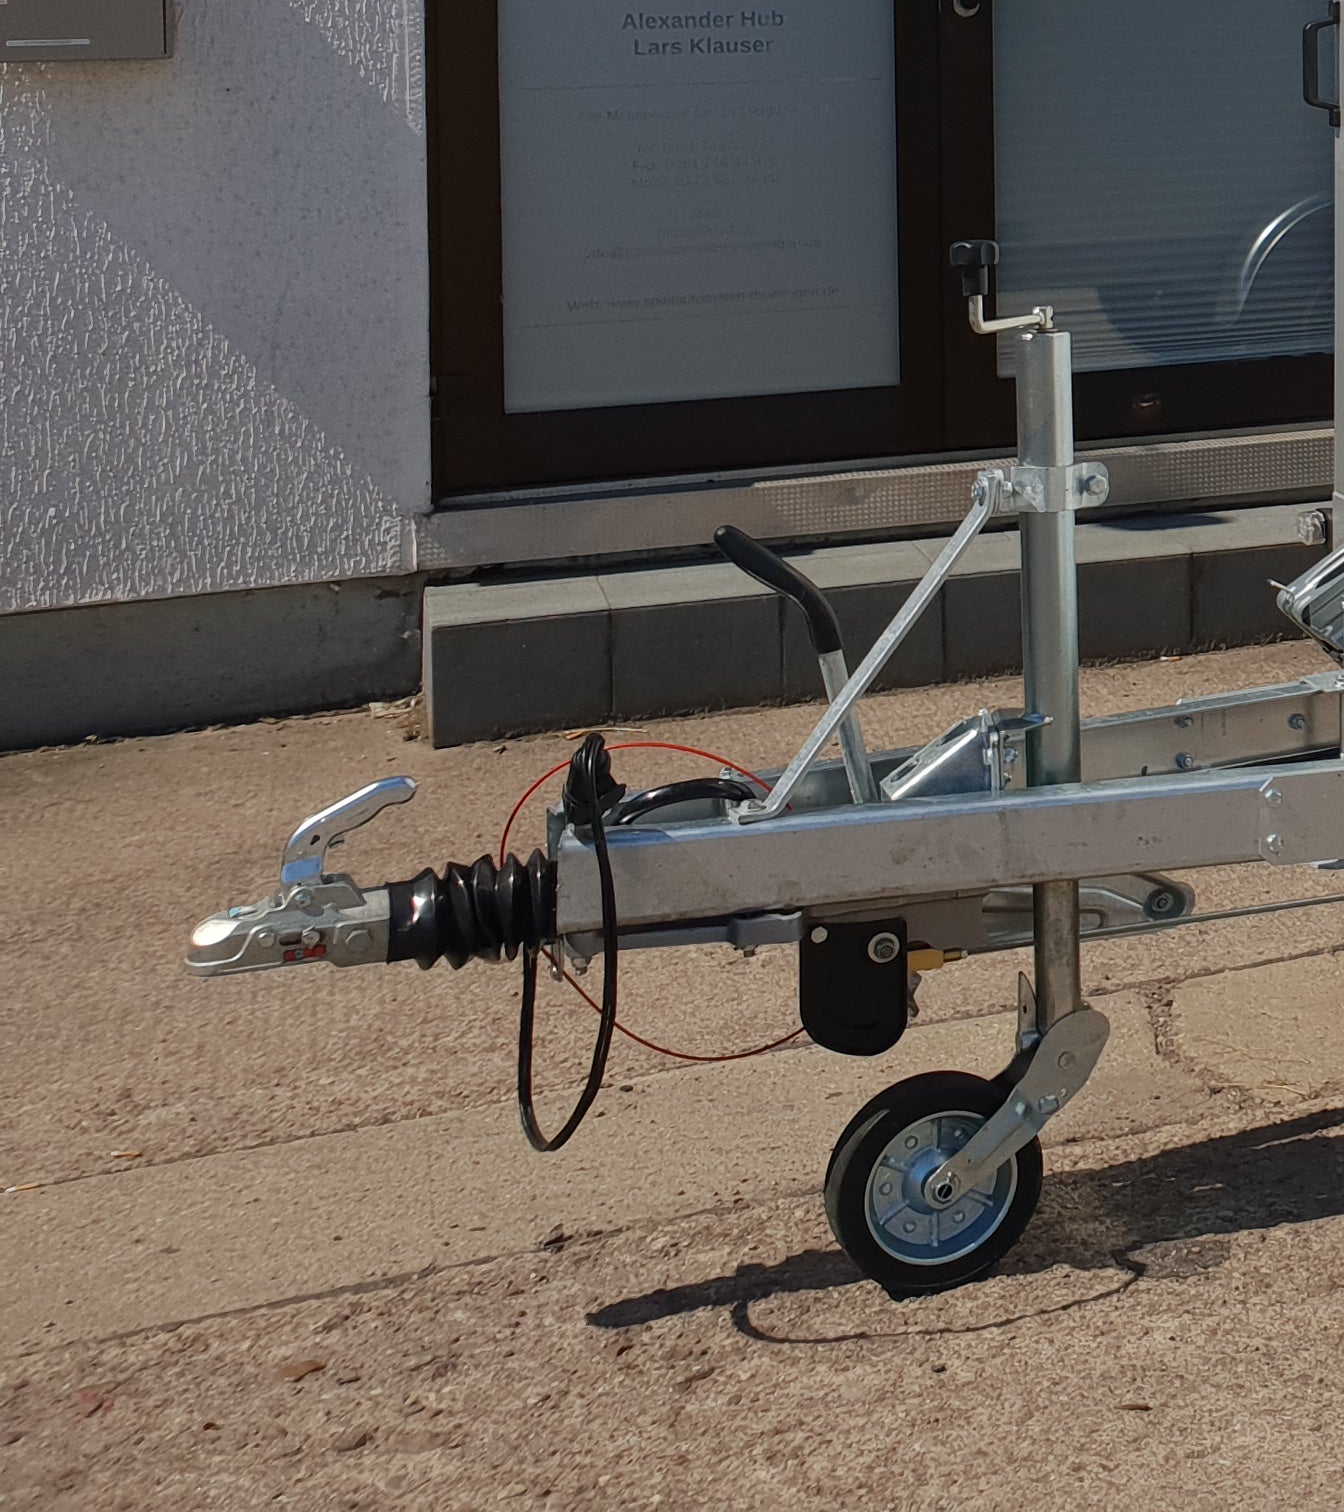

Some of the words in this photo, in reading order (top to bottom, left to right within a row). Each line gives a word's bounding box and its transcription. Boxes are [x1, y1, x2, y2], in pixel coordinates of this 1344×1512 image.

[620, 10, 735, 31] Alexander
[739, 8, 784, 29] Hub
[633, 36, 683, 57] Lars
[689, 35, 775, 56] Klauser
